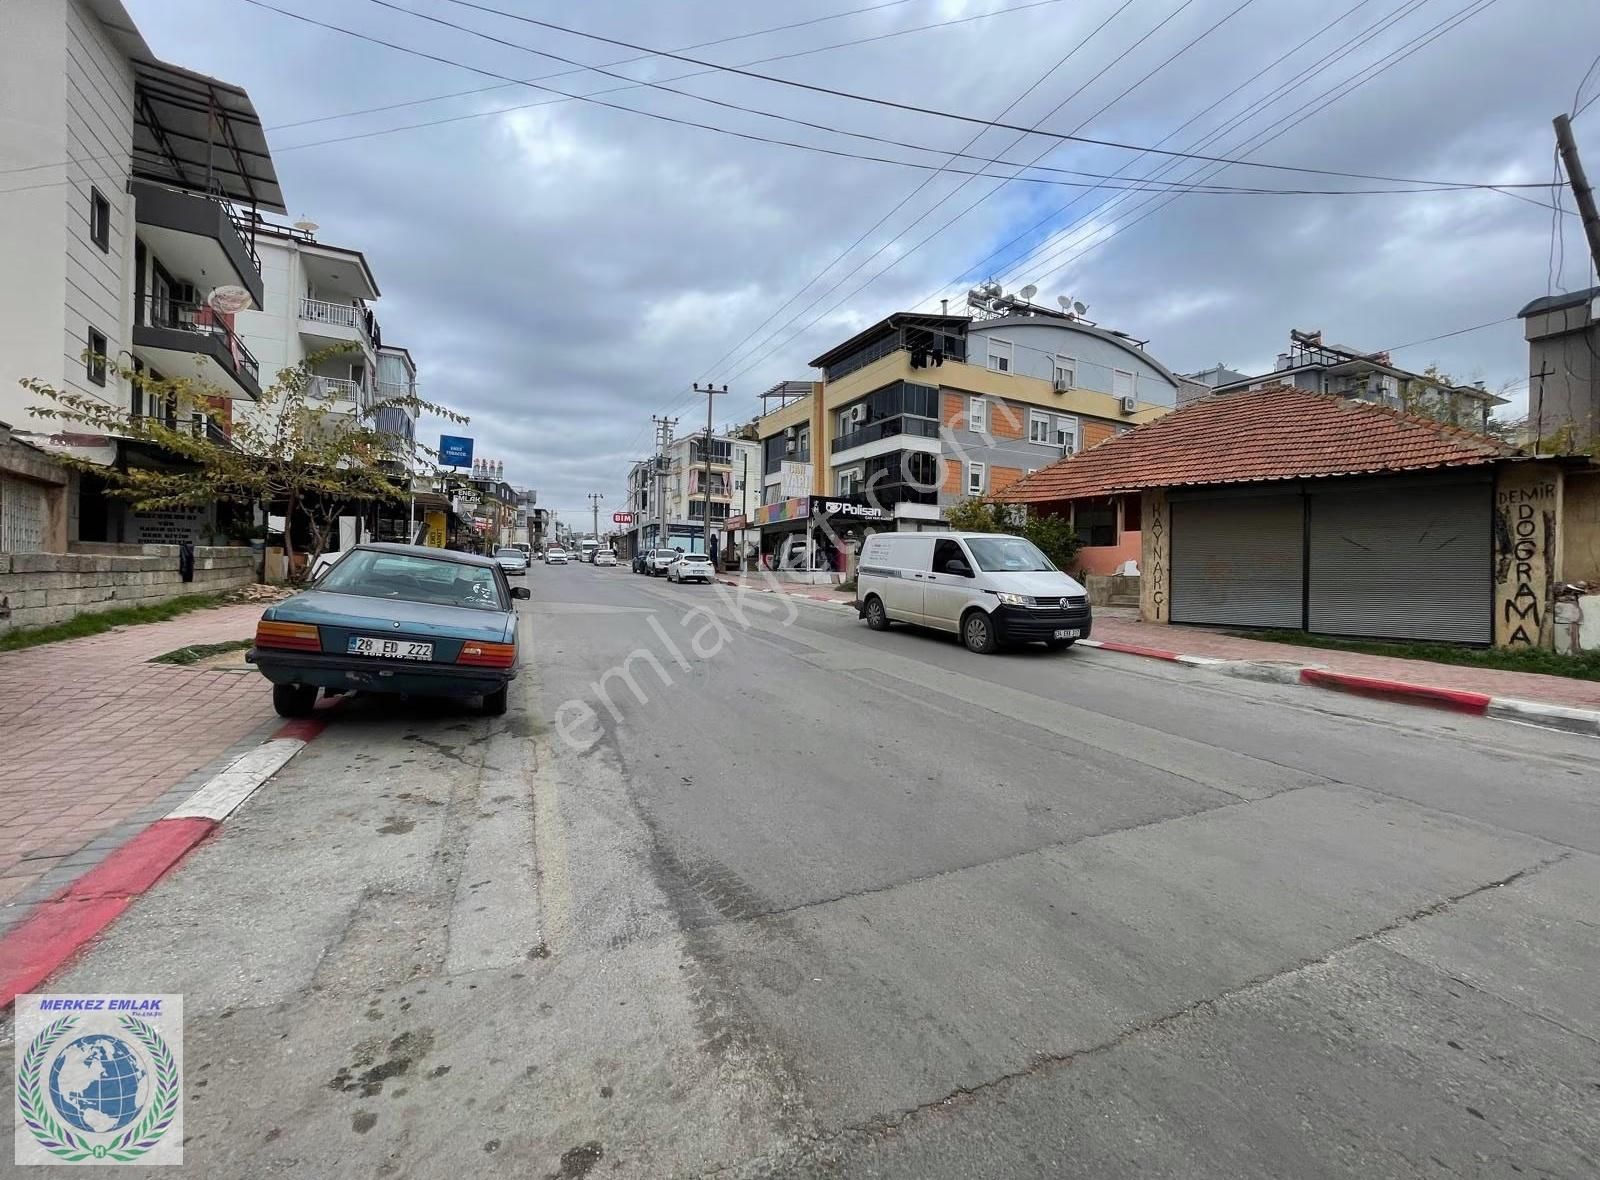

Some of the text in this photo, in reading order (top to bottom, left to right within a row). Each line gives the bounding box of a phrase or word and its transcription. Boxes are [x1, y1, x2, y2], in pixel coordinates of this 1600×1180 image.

[843, 503, 881, 517] Polisan
[357, 638, 431, 657] 28 ED 222
